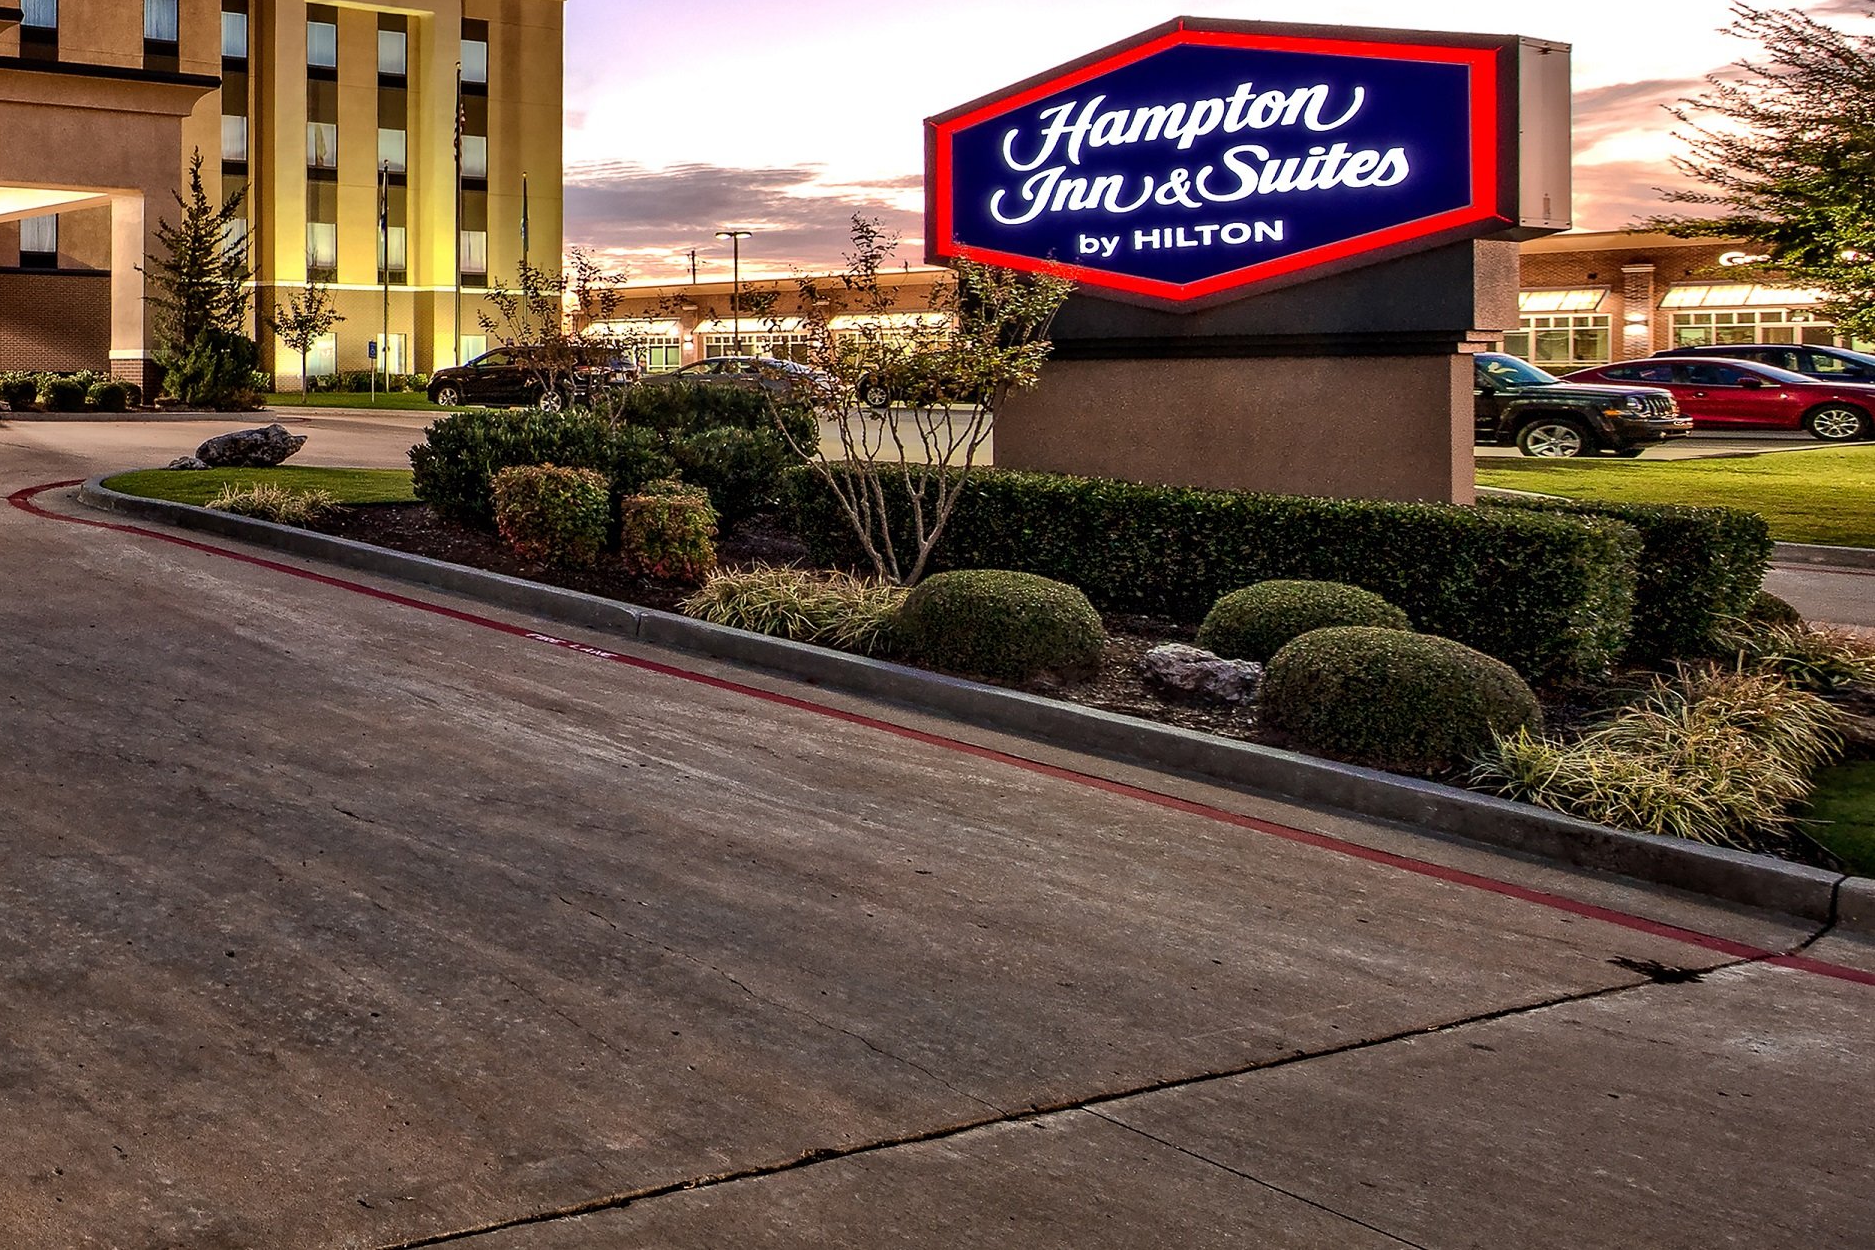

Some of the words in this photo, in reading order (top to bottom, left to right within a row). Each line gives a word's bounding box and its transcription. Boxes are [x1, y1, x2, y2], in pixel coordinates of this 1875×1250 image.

[1002, 82, 1365, 171] Hampton
[990, 166, 1154, 225] Inn
[1155, 169, 1203, 208] &
[1195, 143, 1410, 202] Suites
[1079, 233, 1120, 258] by
[1134, 219, 1284, 251] HILTON
